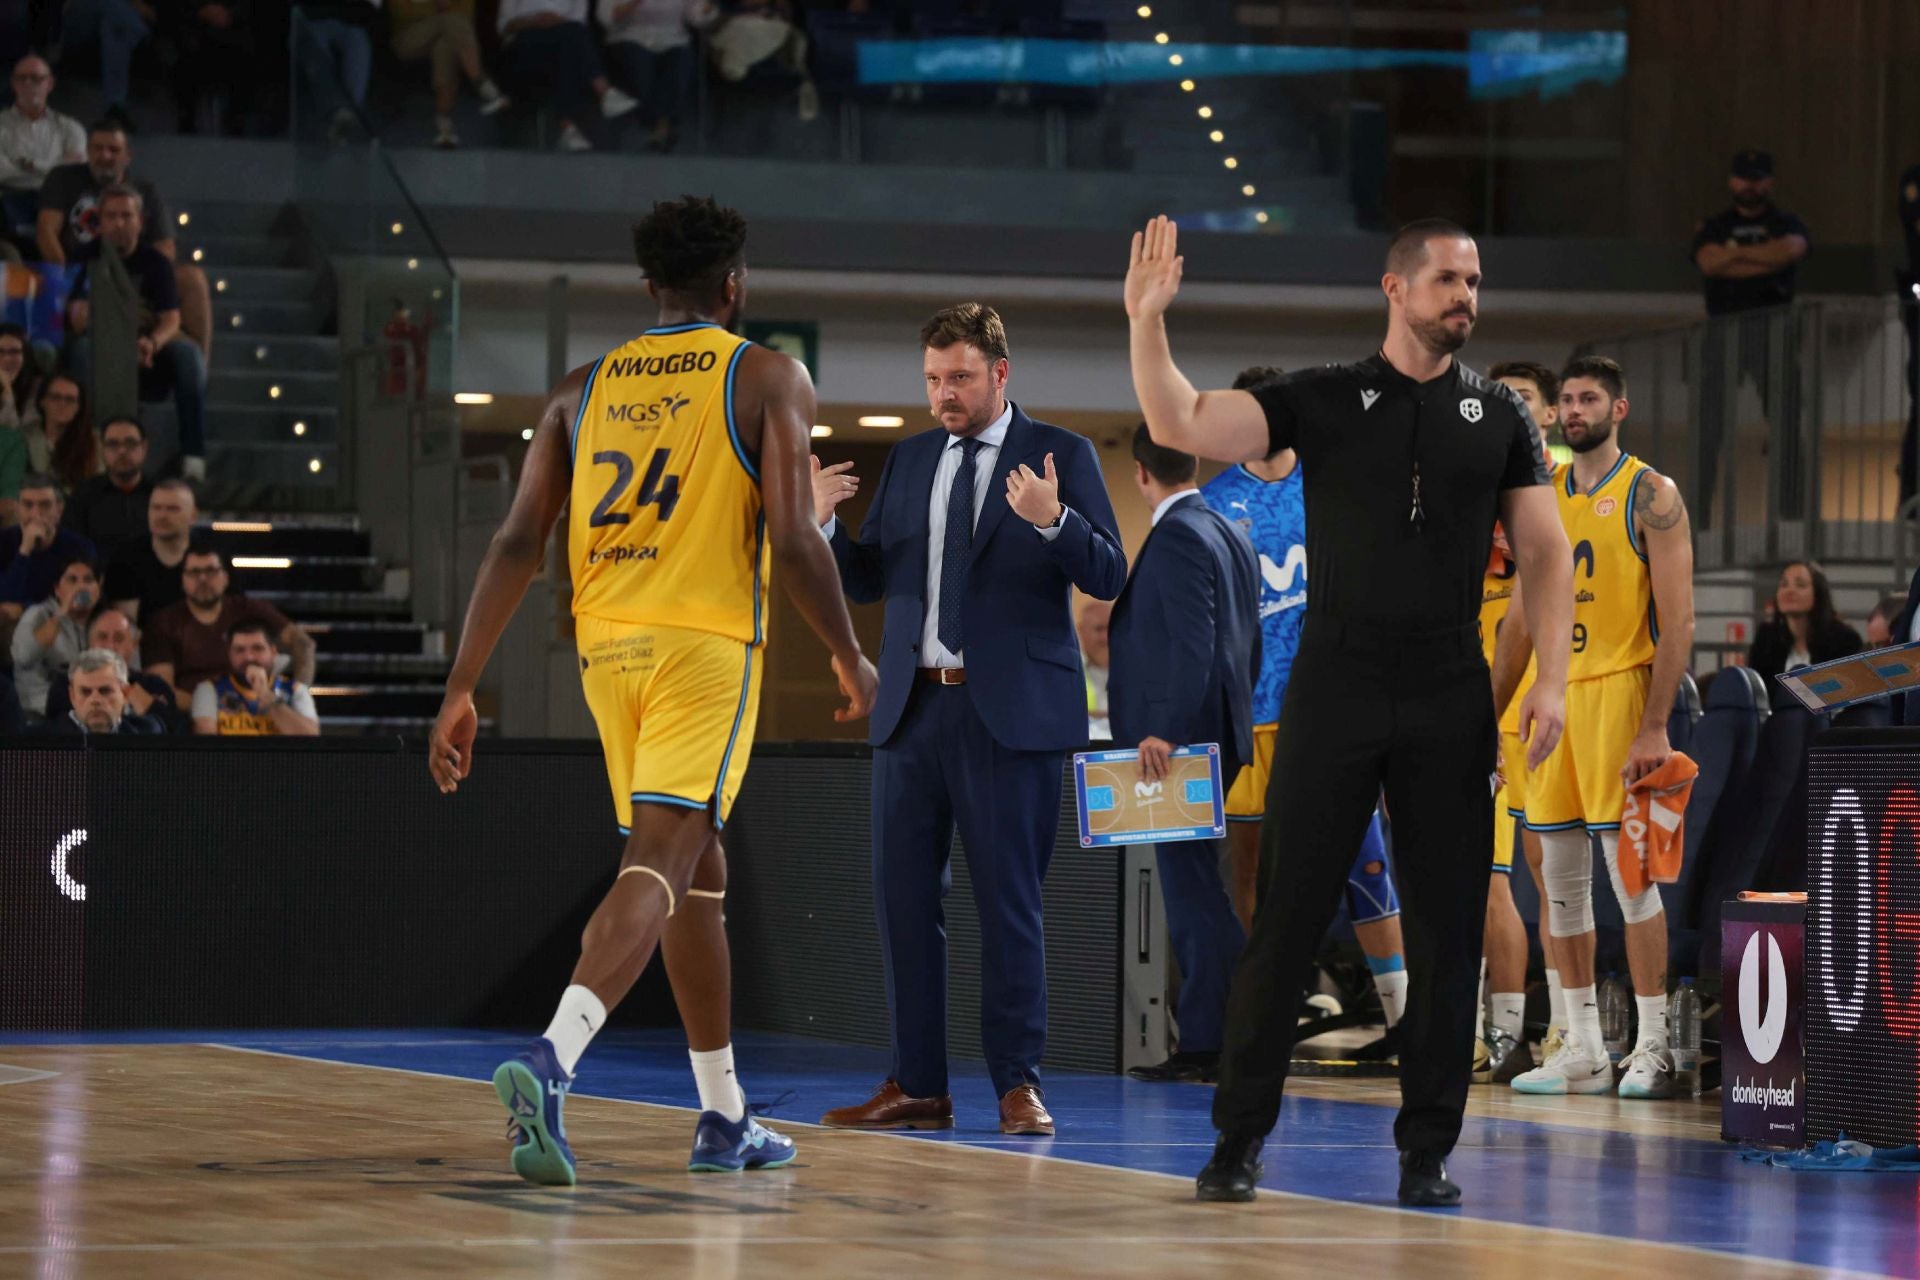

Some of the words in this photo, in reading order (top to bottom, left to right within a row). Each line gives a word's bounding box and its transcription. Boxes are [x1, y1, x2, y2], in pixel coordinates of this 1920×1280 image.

[606, 351, 717, 378] NWOGBO
[606, 403, 661, 422] MGS
[589, 448, 680, 528] 24
[1732, 1075, 1796, 1111] donkeyhead
